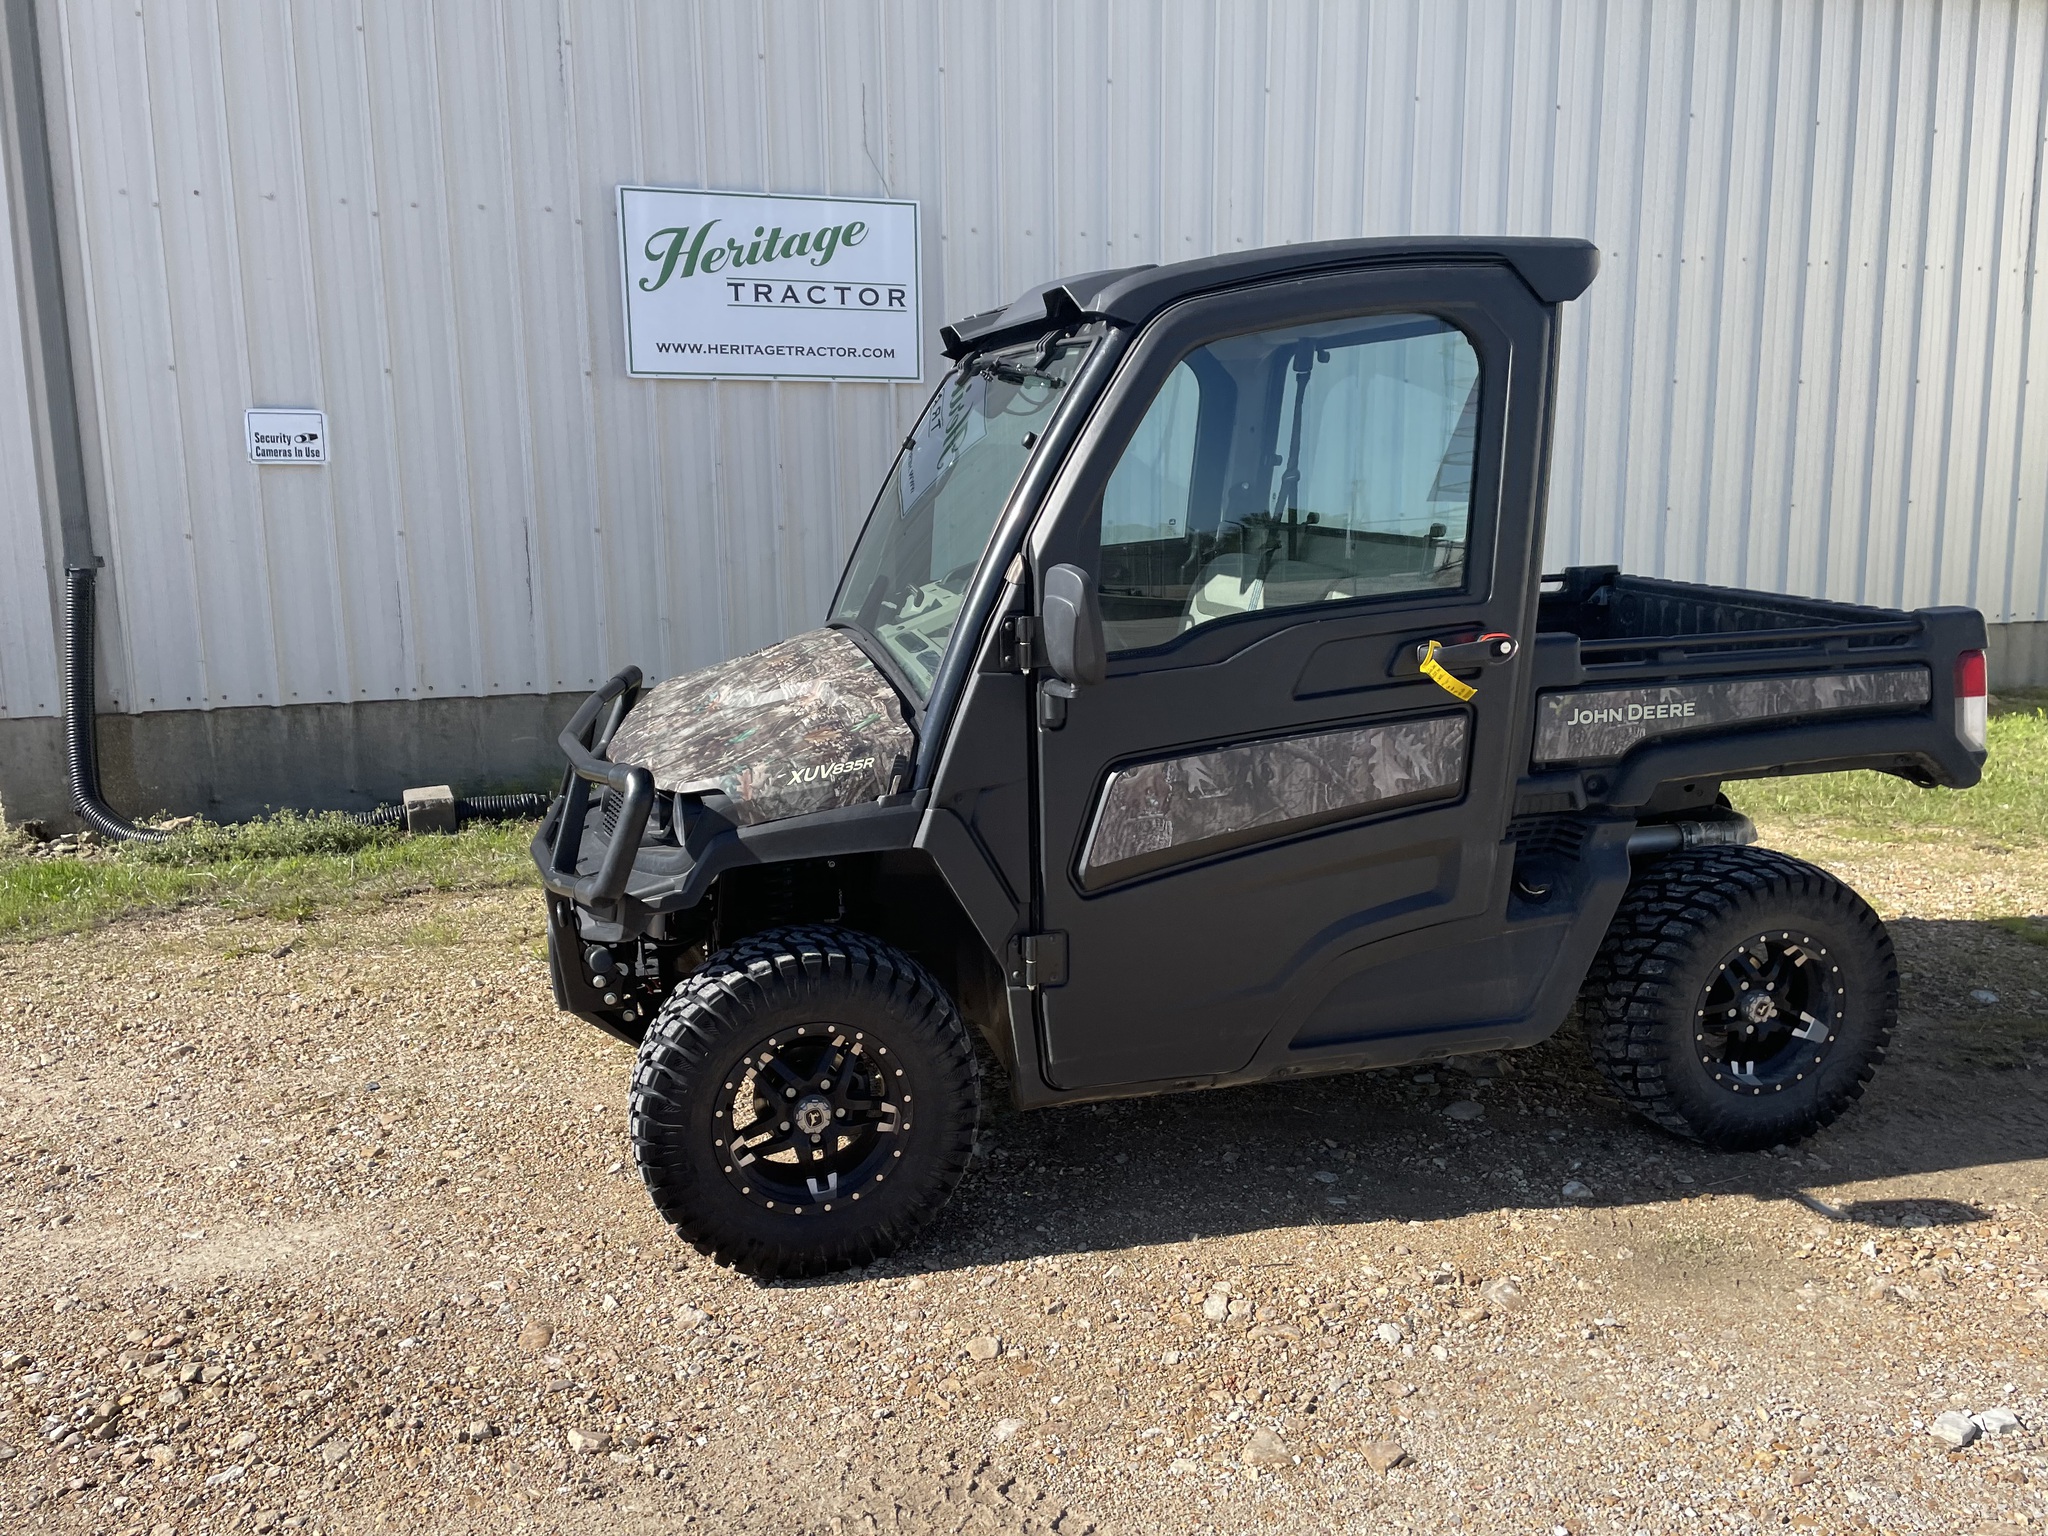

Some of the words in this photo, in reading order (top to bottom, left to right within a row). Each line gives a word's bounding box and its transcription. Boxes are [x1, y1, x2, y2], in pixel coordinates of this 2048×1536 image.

[639, 218, 869, 292] Heritage
[727, 282, 907, 307] TRACTOR
[656, 342, 895, 359] WWW.HERITAGETRACTOR.COM
[254, 432, 291, 446] Security
[255, 446, 292, 457] Cameras
[295, 446, 303, 457] In
[305, 446, 320, 458] Use
[1567, 707, 1623, 726] JOHN
[1628, 702, 1696, 721] DEERE
[787, 757, 875, 785] XUV835R
